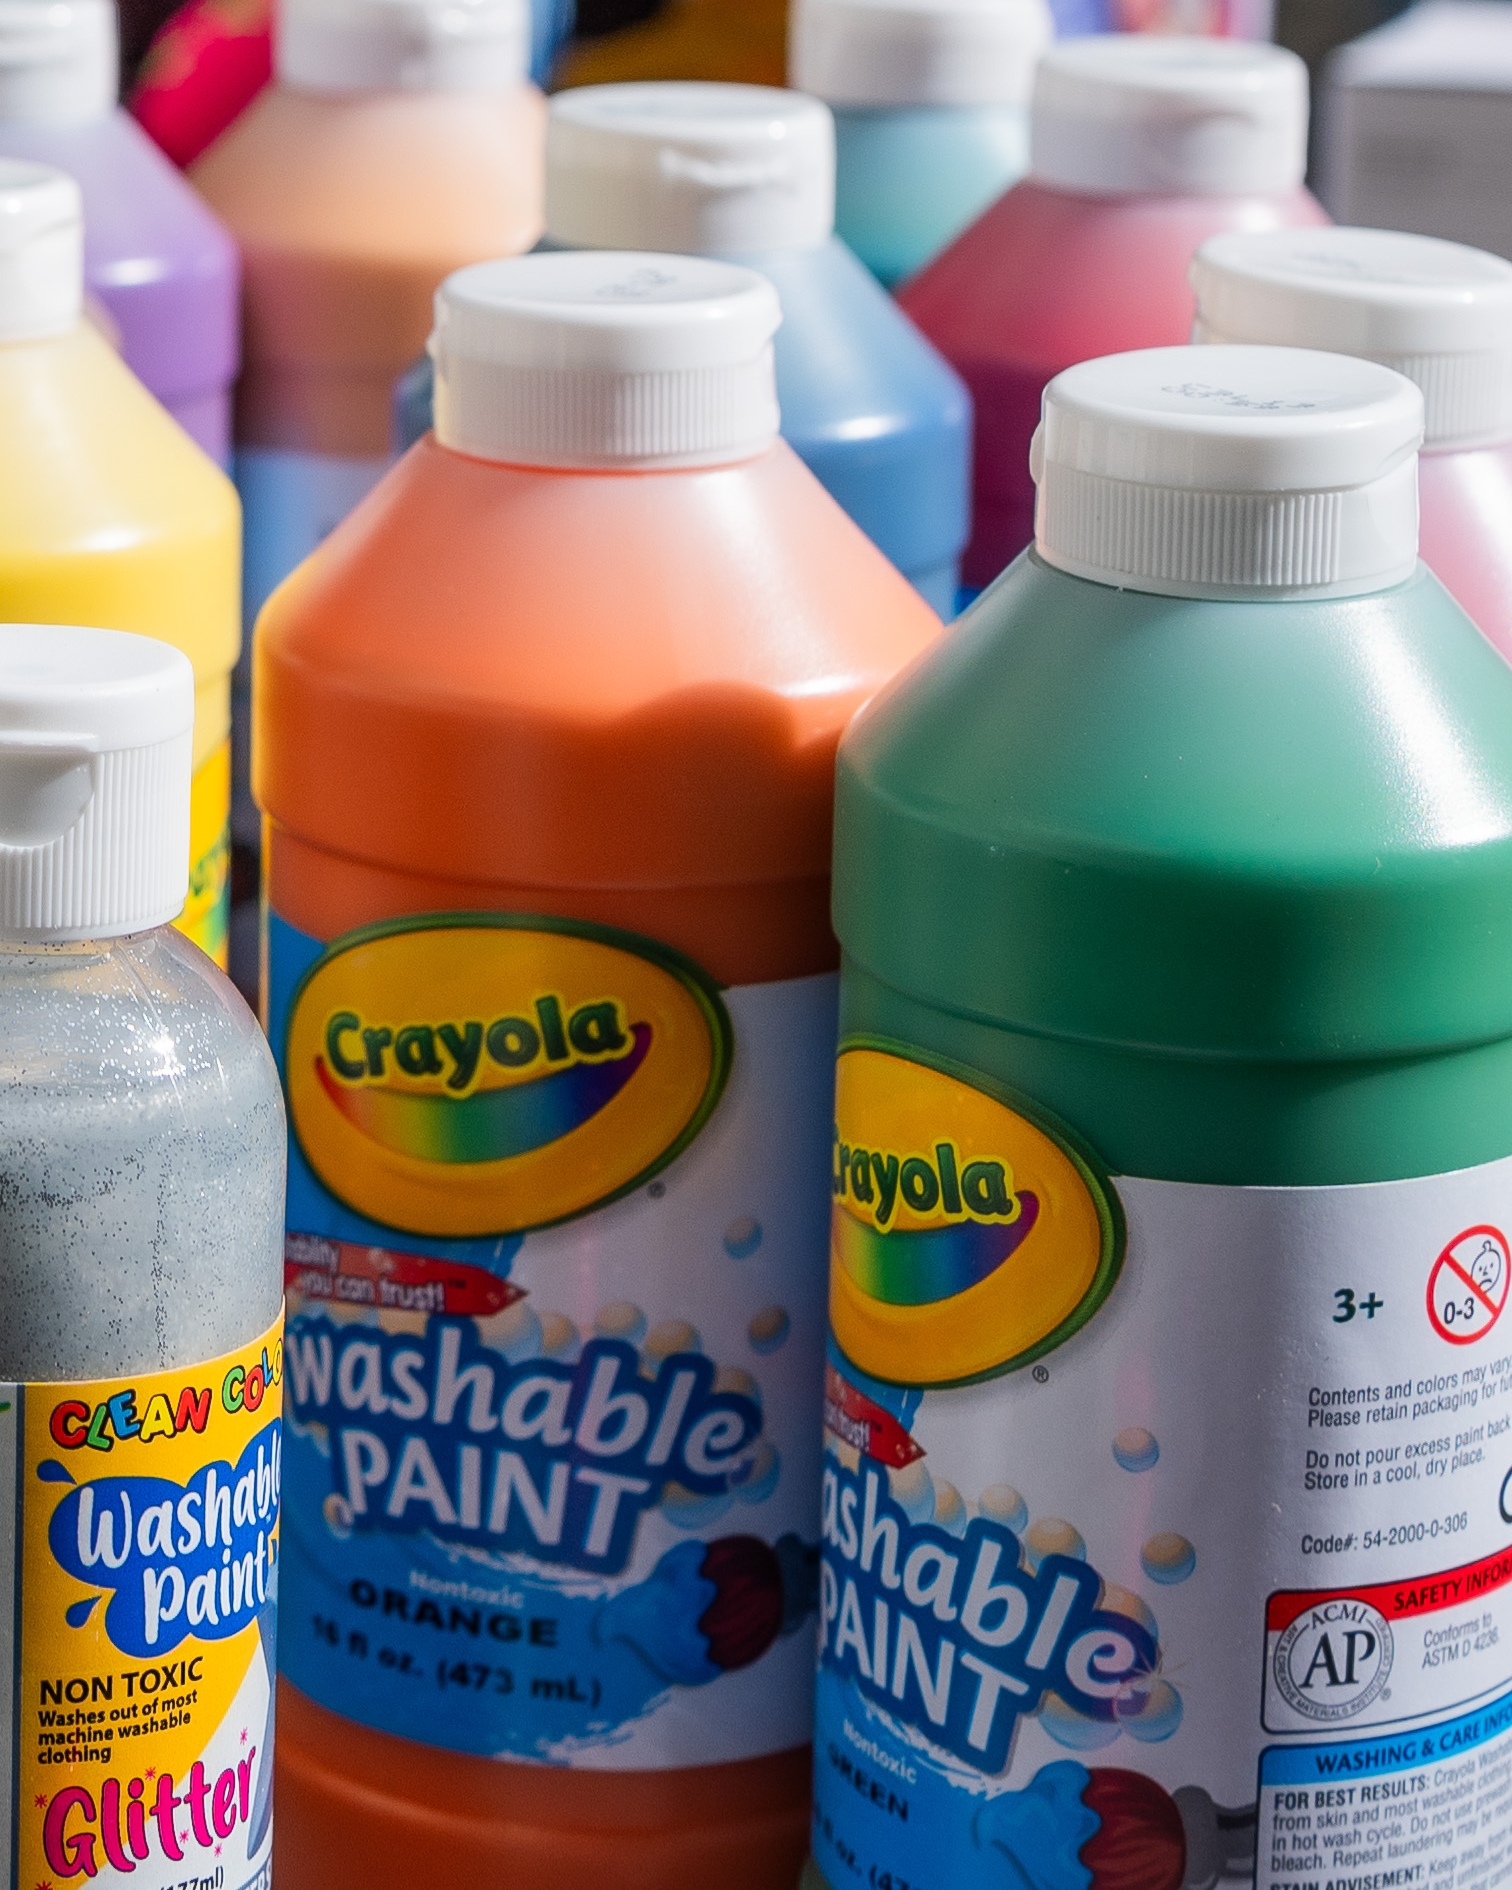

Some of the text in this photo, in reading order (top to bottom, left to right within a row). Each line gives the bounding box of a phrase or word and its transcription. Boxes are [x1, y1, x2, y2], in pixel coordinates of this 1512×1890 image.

[326, 994, 626, 1091] Crayola
[836, 1142, 1014, 1225] rayola
[1333, 1288, 1383, 1323] 3+
[1443, 1297, 1475, 1325] 0-3
[50, 1338, 284, 1452] CLEAN COLO
[1308, 1384, 1380, 1408] Contents
[1385, 1379, 1412, 1400] and
[1416, 1372, 1458, 1396] colors
[1462, 1362, 1486, 1385] may
[1308, 1406, 1361, 1428] Please
[1366, 1399, 1408, 1424] retain
[1412, 1388, 1478, 1420] packaging
[1481, 1380, 1497, 1400] for
[1306, 1450, 1329, 1469] Do
[1334, 1447, 1361, 1468] not
[1365, 1444, 1401, 1468] pour
[1405, 1437, 1451, 1460] excess
[1455, 1425, 1484, 1448] paint
[1487, 1414, 1511, 1438] back
[1304, 1445, 1486, 1491] Store in a cool, dry place.
[77, 1428, 281, 1569] Washabl
[340, 1430, 653, 1557] PAINT
[1301, 1511, 1468, 1555] Code#: 54-2000-0-306
[823, 1468, 1136, 1700] ashable
[1394, 1578, 1464, 1611] SAFETY
[349, 1578, 559, 1648] ORANGE
[1311, 1603, 1367, 1630] ACMI
[1423, 1611, 1493, 1649] Conforms to
[1298, 1630, 1376, 1688] AP
[1421, 1643, 1459, 1670] ASTM
[1462, 1638, 1472, 1658] D
[39, 1656, 204, 1706] NON TOXIC
[38, 1689, 198, 1727] Washes out of most
[38, 1711, 192, 1746] machine washable
[37, 1745, 112, 1765] clothing
[1316, 1741, 1417, 1775] WASHING
[1421, 1738, 1435, 1758] &
[1439, 1720, 1481, 1752] CARE
[43, 1745, 256, 1878] Glitter
[1273, 1813, 1312, 1831] from
[1316, 1808, 1348, 1829] skin
[1352, 1802, 1379, 1825] and
[1384, 1796, 1419, 1820] most
[1274, 1790, 1309, 1811] FOR
[1314, 1787, 1354, 1809] BEST
[1361, 1774, 1431, 1803] RESULTS:
[1271, 1851, 1327, 1873] bleach.
[1332, 1844, 1384, 1870] Repeat
[1387, 1829, 1454, 1862] laundering
[1272, 1833, 1287, 1851] in
[1292, 1831, 1318, 1850] hot
[1323, 1824, 1362, 1848] wash
[1366, 1821, 1406, 1844] cycle.
[1410, 1815, 1429, 1834] Do
[1432, 1806, 1452, 1828] not
